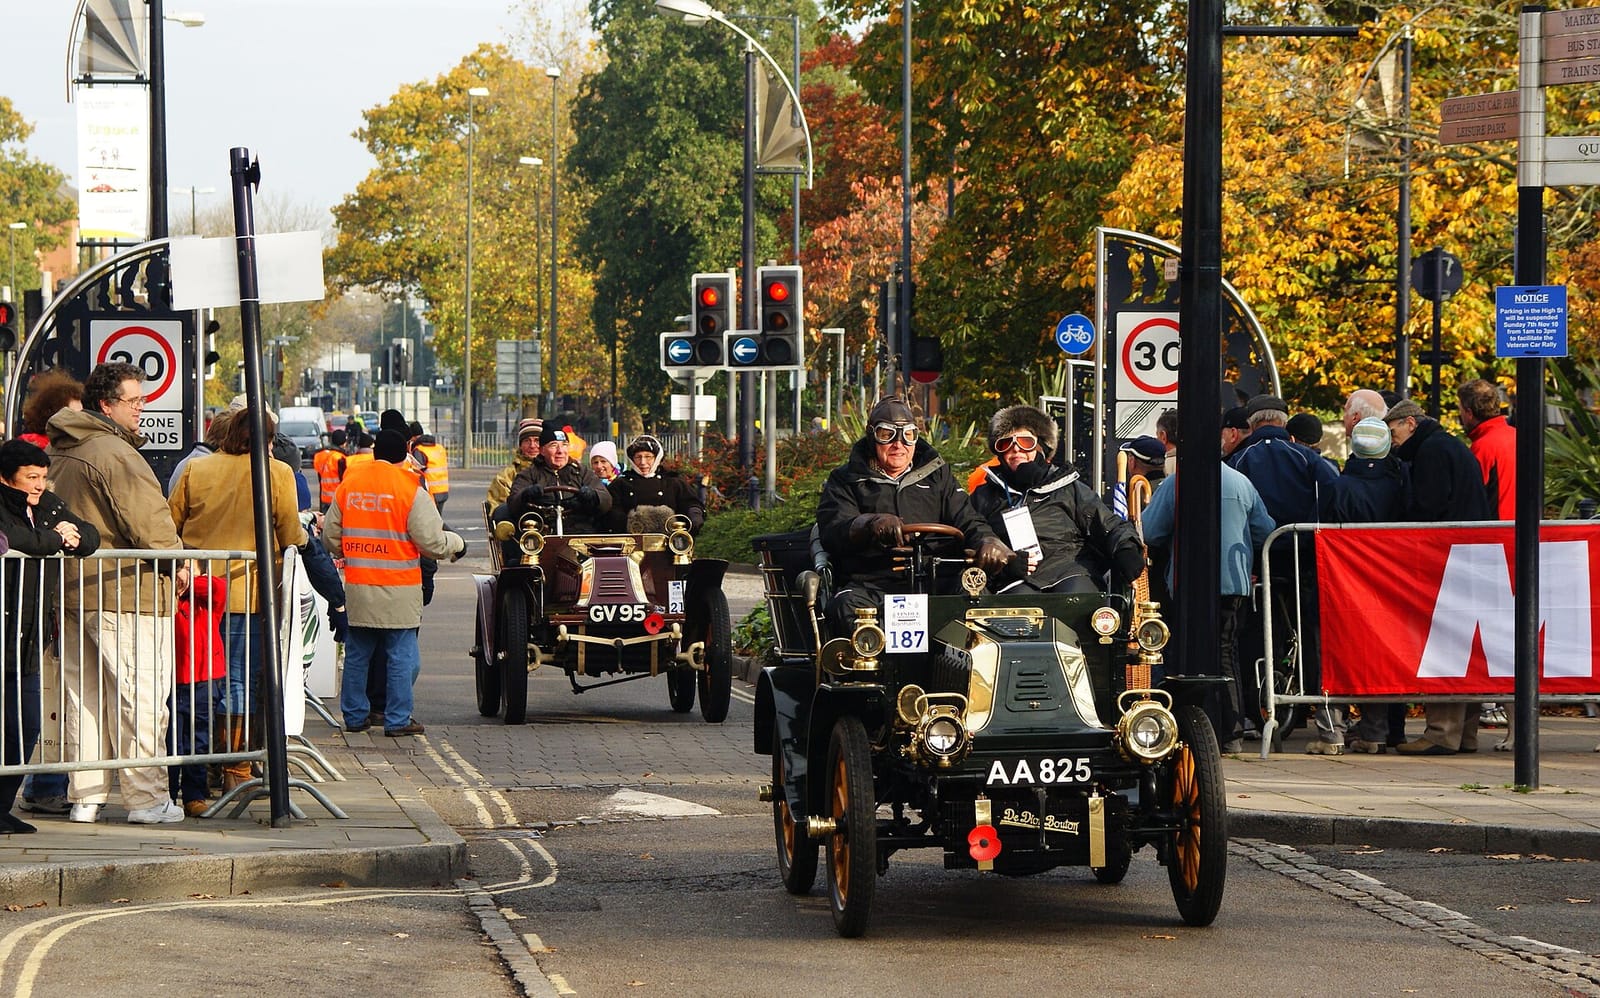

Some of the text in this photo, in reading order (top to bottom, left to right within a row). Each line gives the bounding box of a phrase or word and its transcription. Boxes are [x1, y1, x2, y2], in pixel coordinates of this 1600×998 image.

[1567, 40, 1585, 52] BUS
[1561, 65, 1590, 78] TRAIN
[1443, 101, 1476, 116] ORCHARD
[1477, 100, 1486, 112] ST
[1487, 99, 1502, 111] CAR
[1456, 122, 1506, 138] LEISURE PARK
[1578, 143, 1599, 156] QU
[1514, 294, 1549, 303] NOTICE
[1541, 307, 1556, 315] High
[1134, 341, 1181, 371] 30
[139, 417, 175, 428] ZONE
[141, 431, 178, 444] NDS
[344, 542, 390, 554] OFFICIAL
[589, 604, 647, 623] GV 95
[889, 631, 925, 649] 187
[986, 757, 1091, 785] AA 825
[1003, 808, 1019, 822] De
[1044, 814, 1080, 832] Bouton
